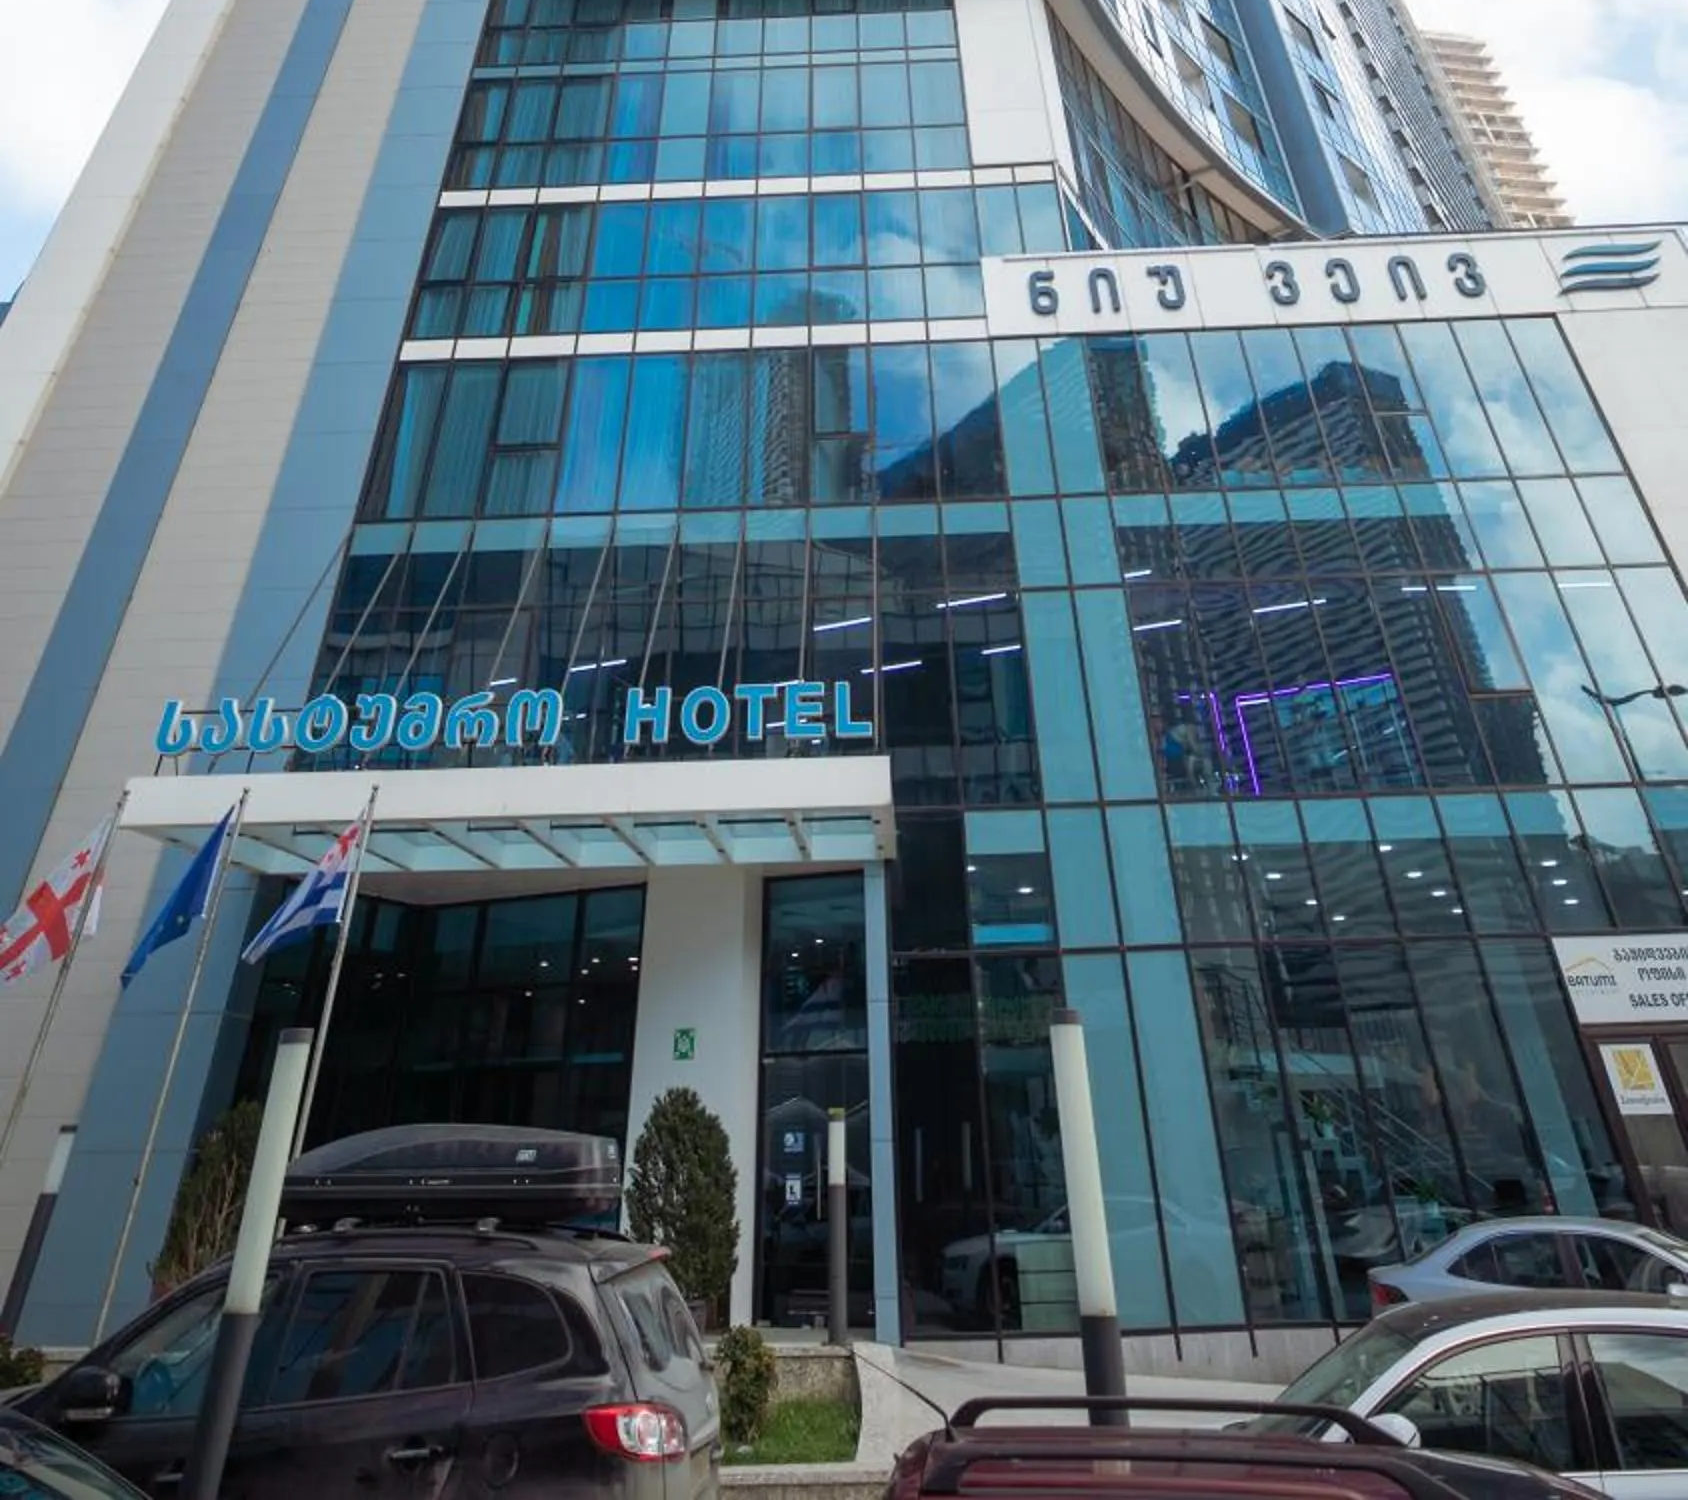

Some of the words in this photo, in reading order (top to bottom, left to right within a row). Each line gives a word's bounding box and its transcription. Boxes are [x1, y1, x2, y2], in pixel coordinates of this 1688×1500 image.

[1027, 264, 1187, 316] ნიუ
[1266, 252, 1488, 306] ვეივ
[155, 687, 563, 756] სასტუმრო
[623, 680, 874, 746] HOTEL
[1629, 993, 1669, 1009] SALES
[1670, 992, 1688, 1008] OF
